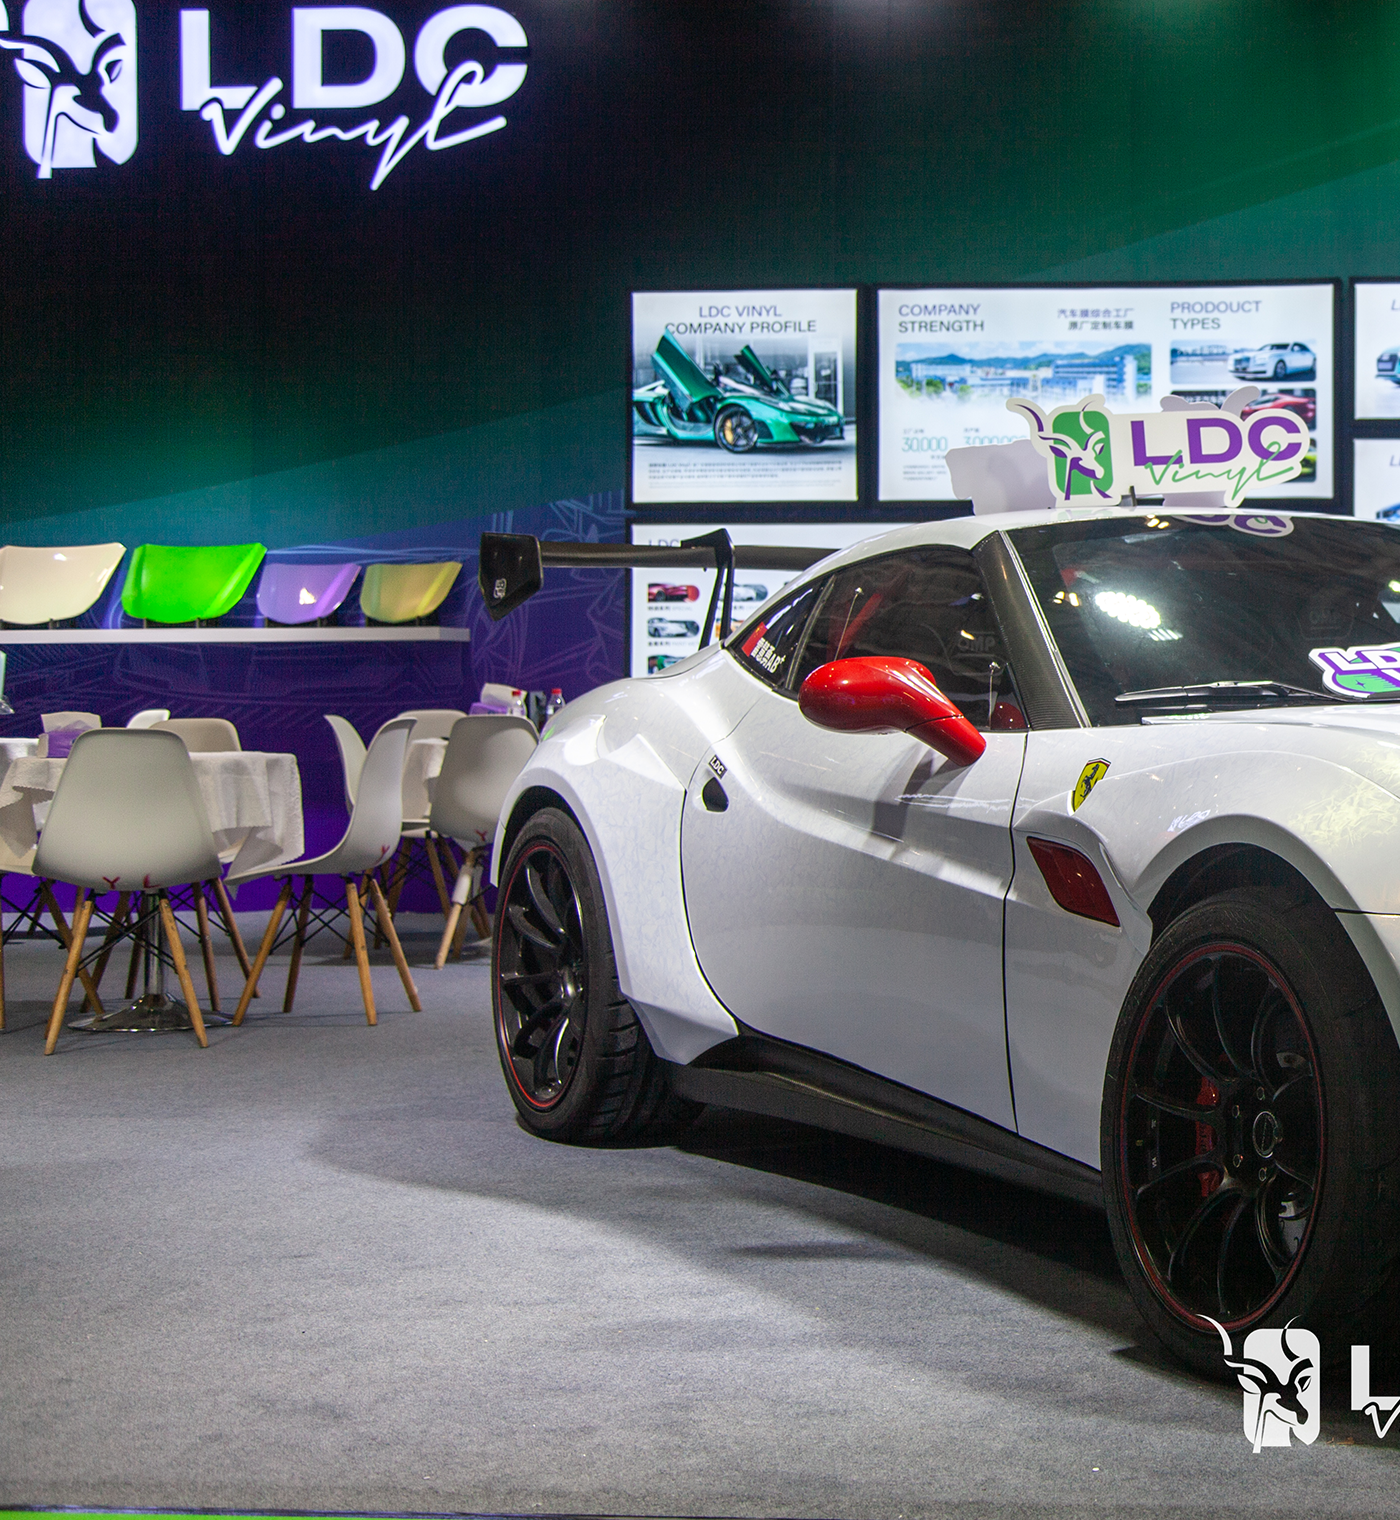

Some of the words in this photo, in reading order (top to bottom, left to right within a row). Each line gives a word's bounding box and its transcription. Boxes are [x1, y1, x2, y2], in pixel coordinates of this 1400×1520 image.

[180, 4, 529, 111] LDC
[201, 60, 507, 191] Vinyl
[699, 306, 731, 318] LDC
[735, 305, 782, 317] VINYL
[898, 303, 981, 317] COMPANY
[1170, 300, 1262, 314] PRODOUCT
[665, 322, 746, 335] COMPANY
[750, 320, 817, 333] PROFILE
[898, 320, 985, 333] STRENGTH
[1171, 318, 1221, 330] TYPES
[1130, 416, 1303, 467] LDC
[1144, 441, 1295, 501] Vinyl
[710, 756, 725, 774] LDC
